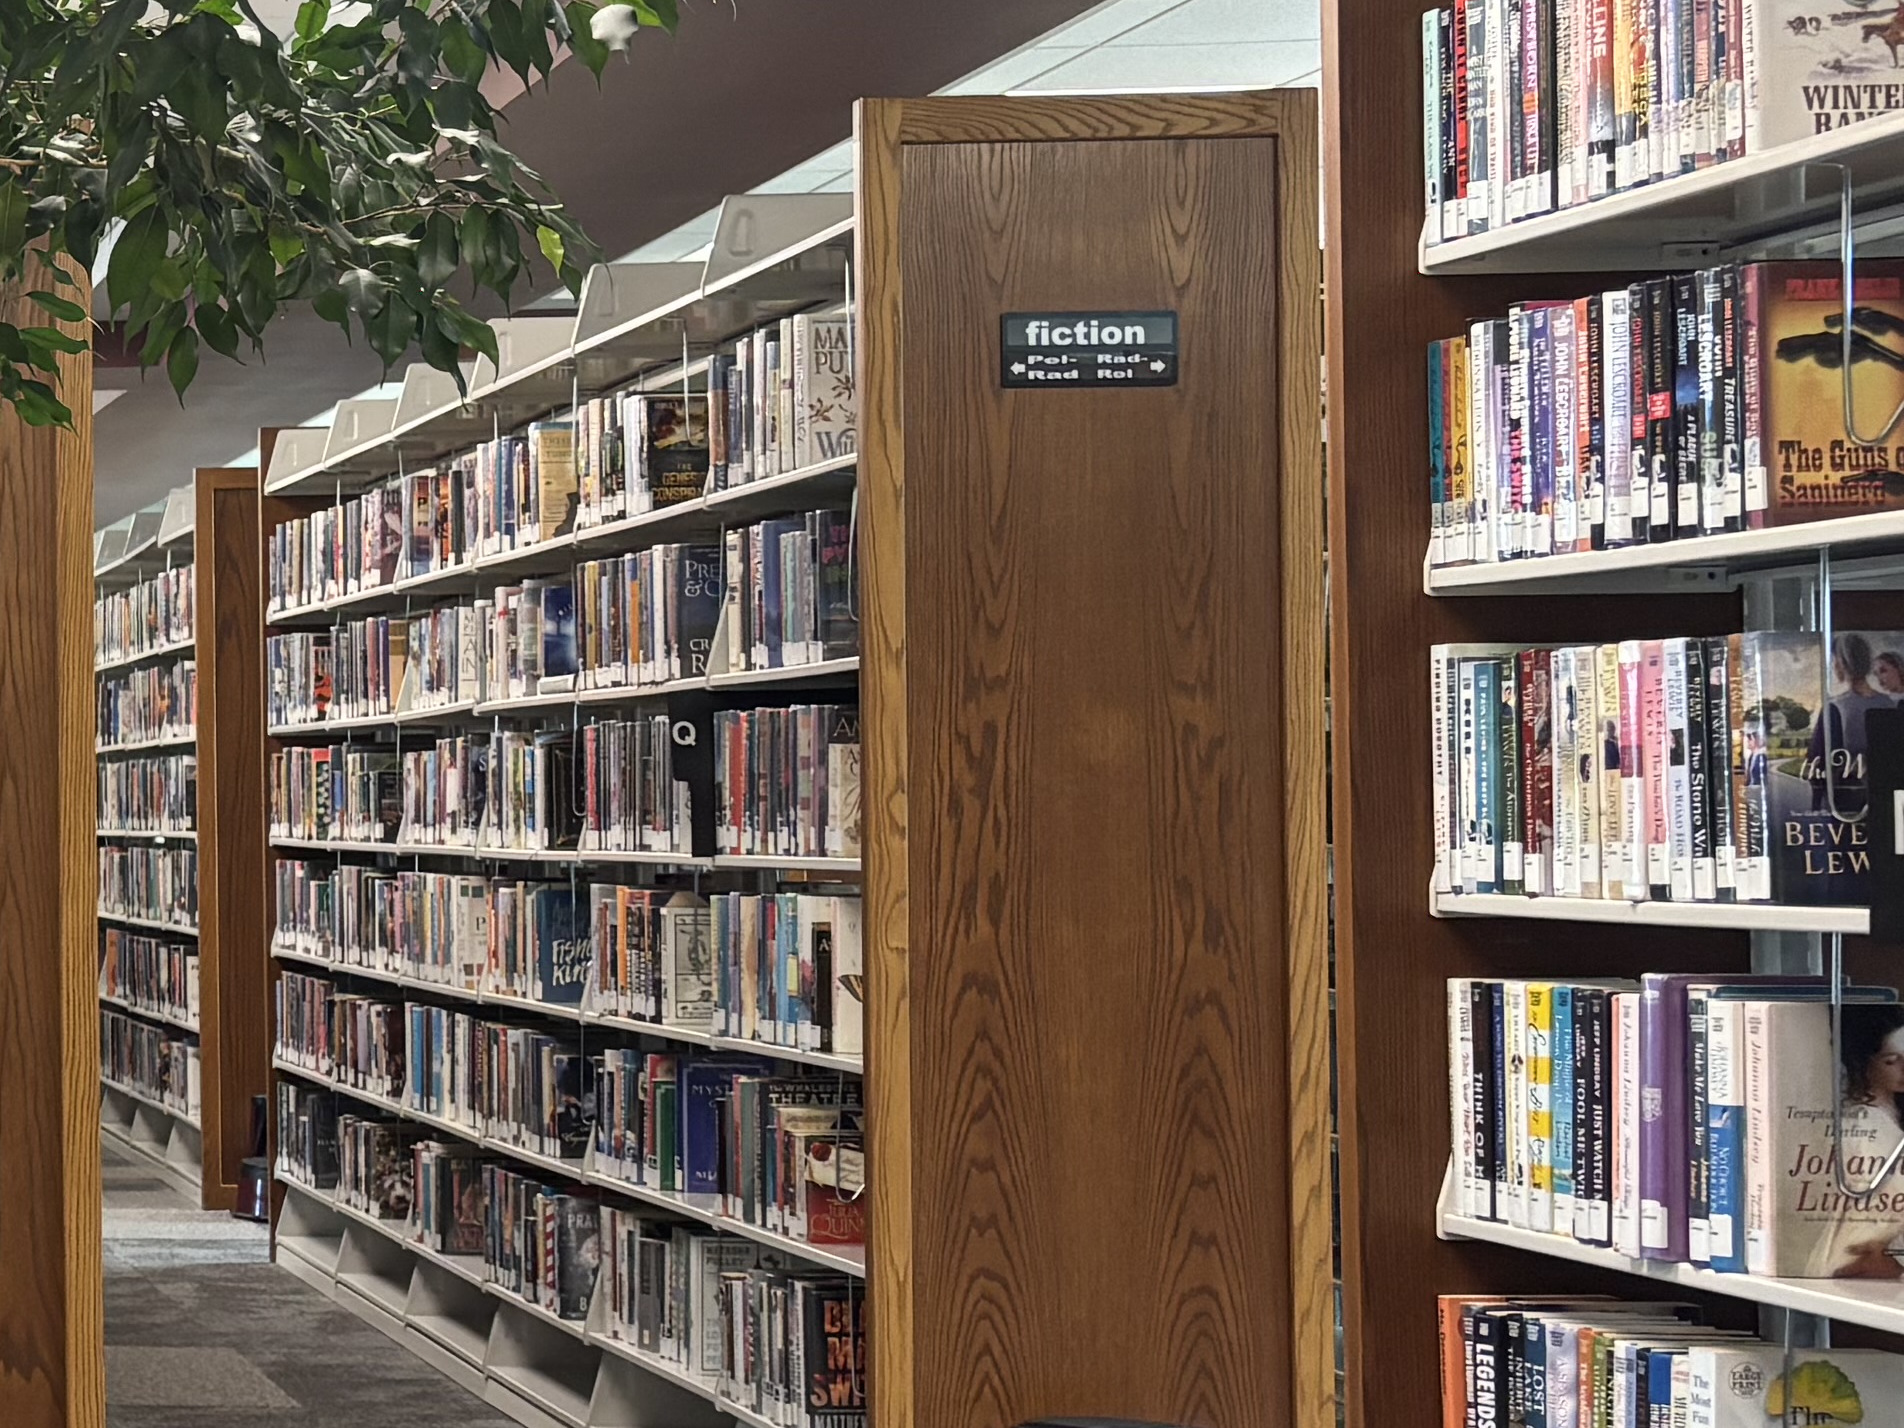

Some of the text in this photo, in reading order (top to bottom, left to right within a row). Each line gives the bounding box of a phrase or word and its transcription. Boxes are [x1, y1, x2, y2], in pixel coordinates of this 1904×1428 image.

[1802, 84, 1904, 111] WINTE
[1025, 320, 1145, 346] fiction
[1555, 341, 1569, 375] JOHN
[1611, 322, 1627, 418] JOHN LESCROART
[1699, 314, 1713, 401] LESCROART
[1723, 378, 1736, 443] TREASURE
[1778, 439, 1889, 473] The Guns
[672, 721, 696, 746] Q
[1525, 759, 1535, 816] Christmas
[1691, 742, 1705, 825] The Stone
[1785, 822, 1868, 846] BEVE
[769, 1093, 859, 1107] THEATRE
[1693, 1041, 1705, 1123] Make Love
[1751, 1041, 1763, 1164] Johanna Lindsey
[1474, 1072, 1485, 1157] THINK OF
[1576, 1078, 1586, 1153] FOOL ME
[1593, 1104, 1604, 1137] JUST
[1593, 1139, 1604, 1187] WATCH
[1515, 1356, 1524, 1414] INHERIT
[1533, 1364, 1545, 1415] LOST
[1691, 1392, 1711, 1408] Most
[1693, 1375, 1708, 1389] The
[1692, 1411, 1710, 1426] Fun
